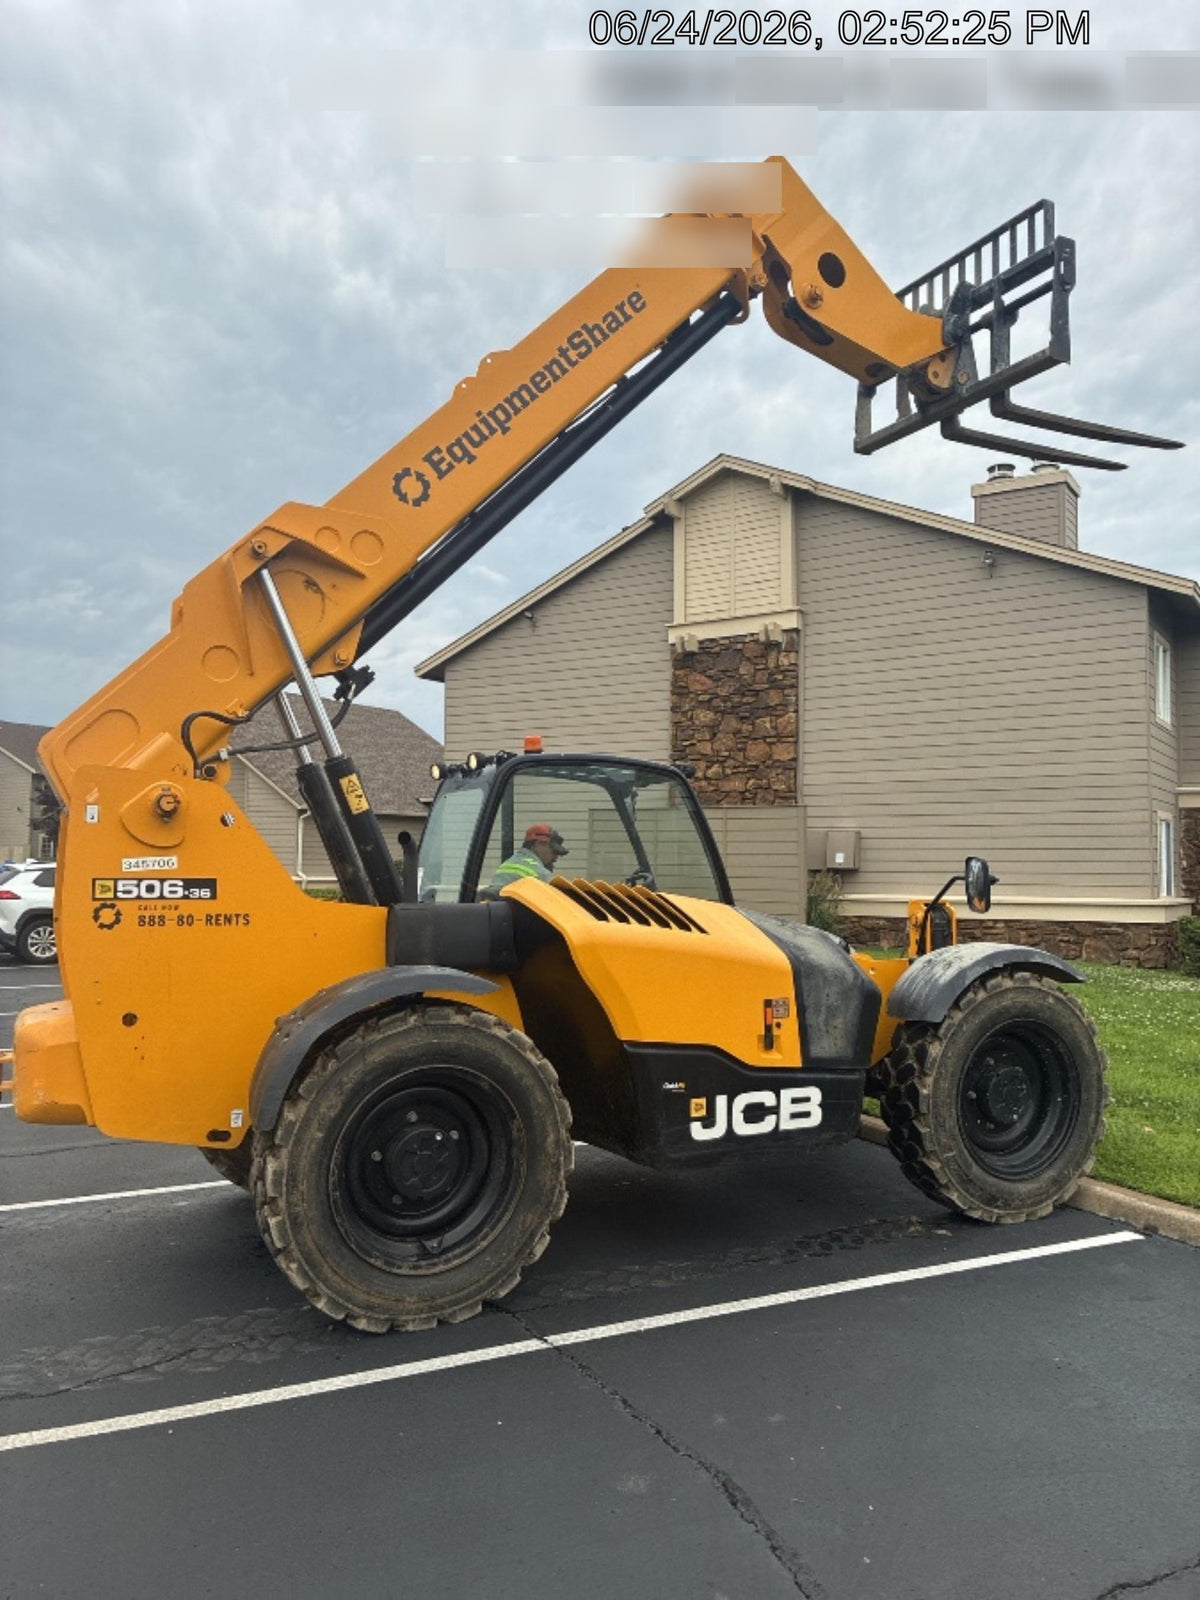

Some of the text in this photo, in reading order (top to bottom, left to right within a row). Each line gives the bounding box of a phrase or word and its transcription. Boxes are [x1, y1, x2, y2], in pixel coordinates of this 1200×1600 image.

[421, 290, 647, 481] EquipmentShare
[137, 913, 251, 927] 888-80-RENTS
[689, 1086, 823, 1141] JCB
